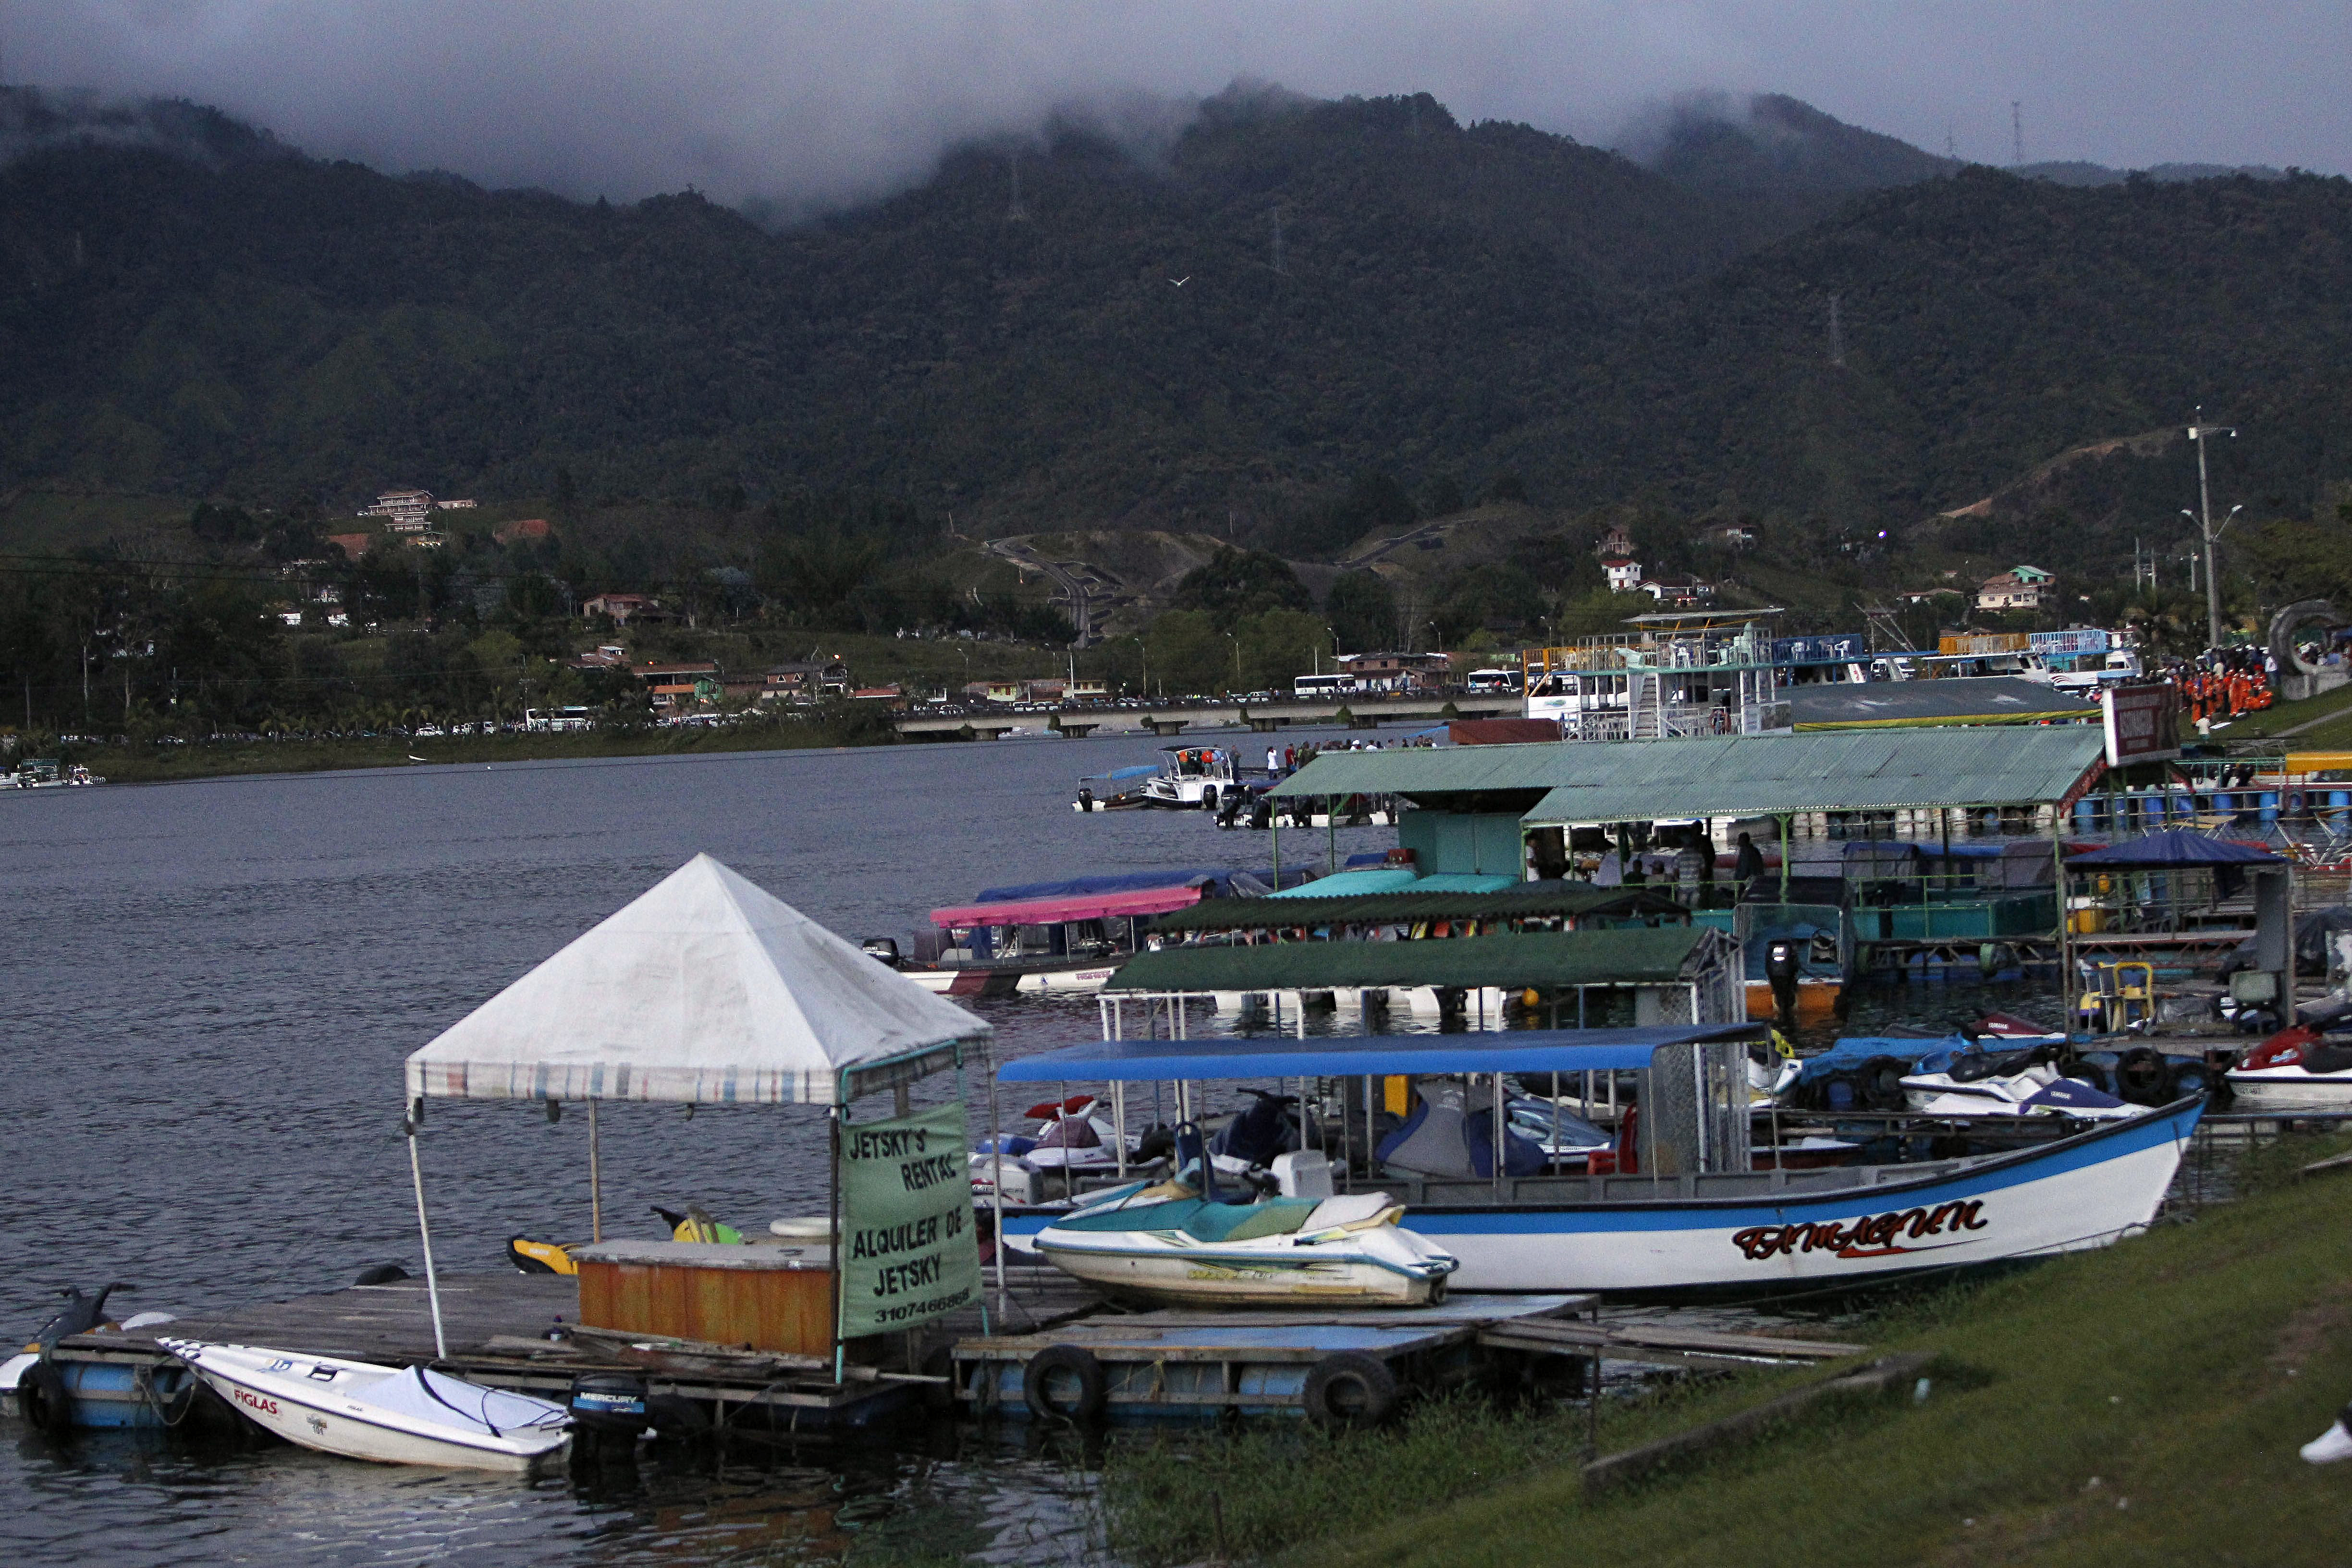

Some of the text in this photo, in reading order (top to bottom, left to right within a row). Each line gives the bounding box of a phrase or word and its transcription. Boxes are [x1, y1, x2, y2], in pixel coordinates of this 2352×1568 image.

[901, 1152, 956, 1191] RENTAL
[853, 1205, 962, 1259] ALQUILER DE
[873, 1252, 941, 1297] JETSKY
[233, 1388, 278, 1415] FIGLAS
[580, 1392, 638, 1403] MERCURY
